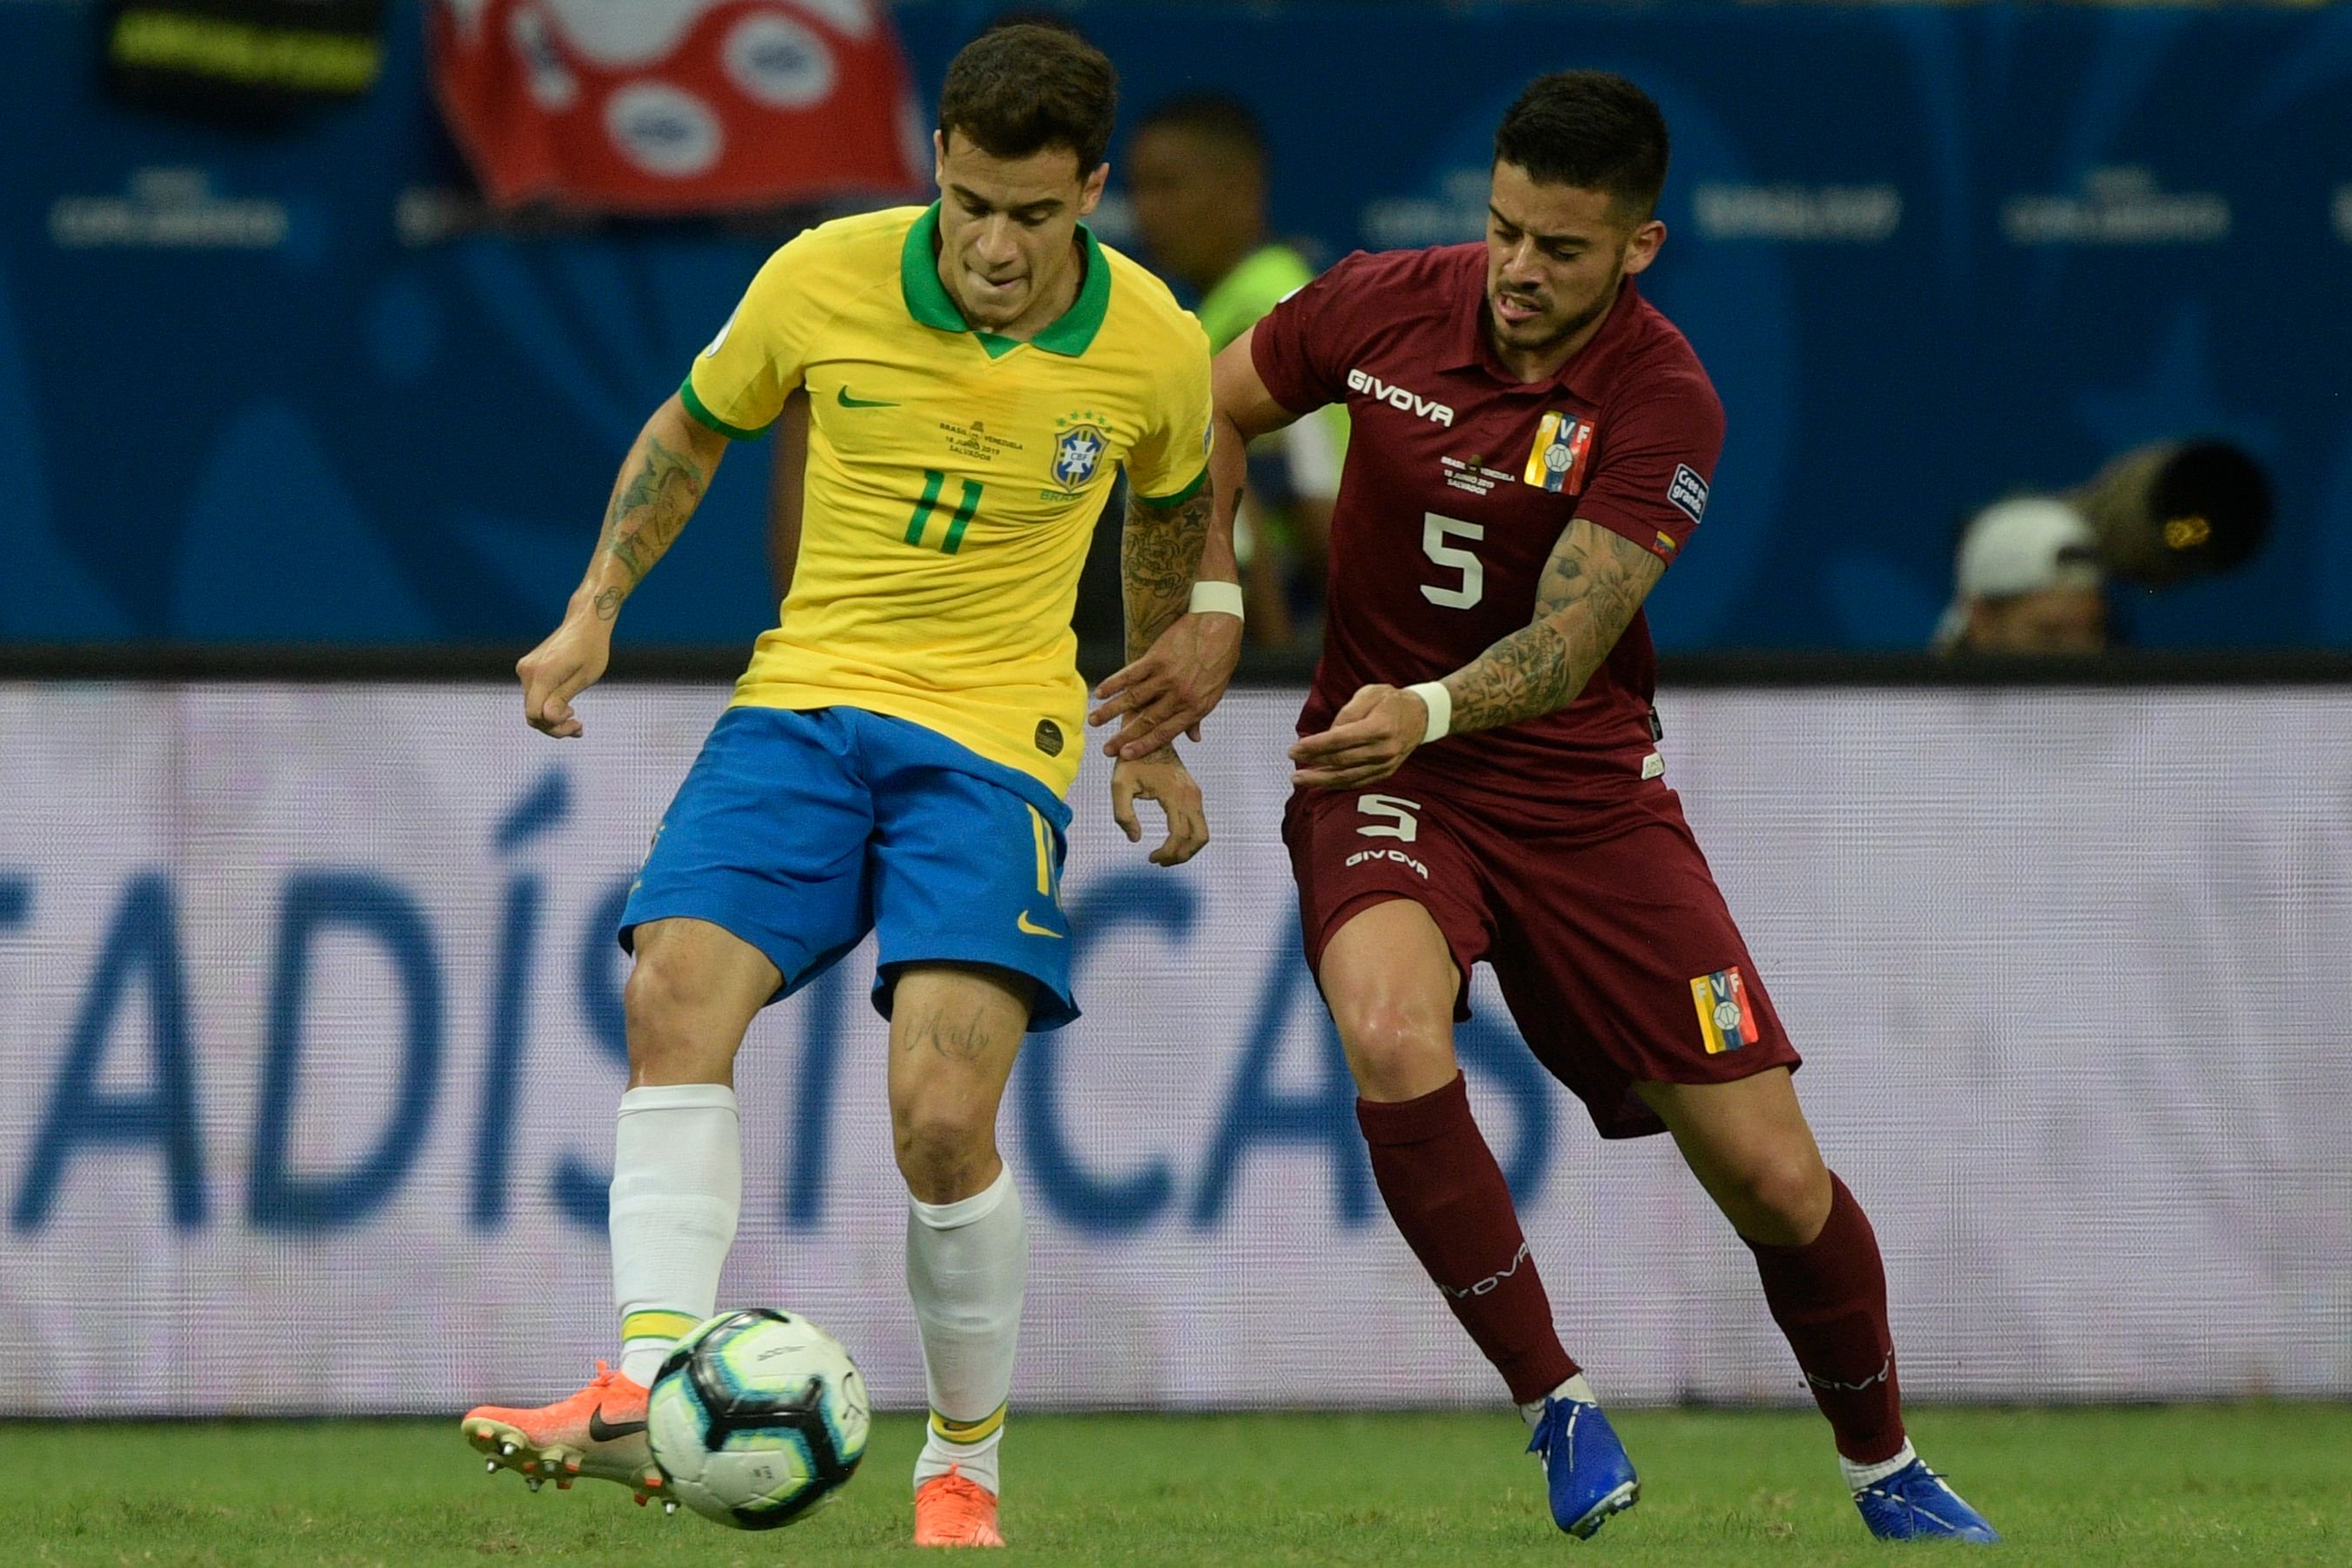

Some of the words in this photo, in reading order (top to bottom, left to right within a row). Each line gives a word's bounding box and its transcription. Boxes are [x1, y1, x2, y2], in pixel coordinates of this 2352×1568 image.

[1347, 369, 1453, 427] GIVOVA
[939, 423, 967, 436] BRASIL
[984, 436, 1023, 450] VENEZUELA
[1540, 414, 1591, 444] FVF
[949, 445, 991, 461] SALVADOR
[982, 445, 1000, 455] 2019
[1071, 452, 1087, 461] CBF
[1440, 456, 1467, 470] BRASIL
[1480, 467, 1515, 483] VENEZUELA
[1678, 470, 1700, 494] Cree
[1039, 489, 1086, 502] BRAS
[1447, 478, 1487, 496] SALVADOR
[905, 469, 984, 555] 11
[1420, 511, 1484, 610] 5
[1356, 793, 1421, 842] 5
[1346, 850, 1428, 880] GIVOVA
[1697, 972, 1740, 1002] FVF
